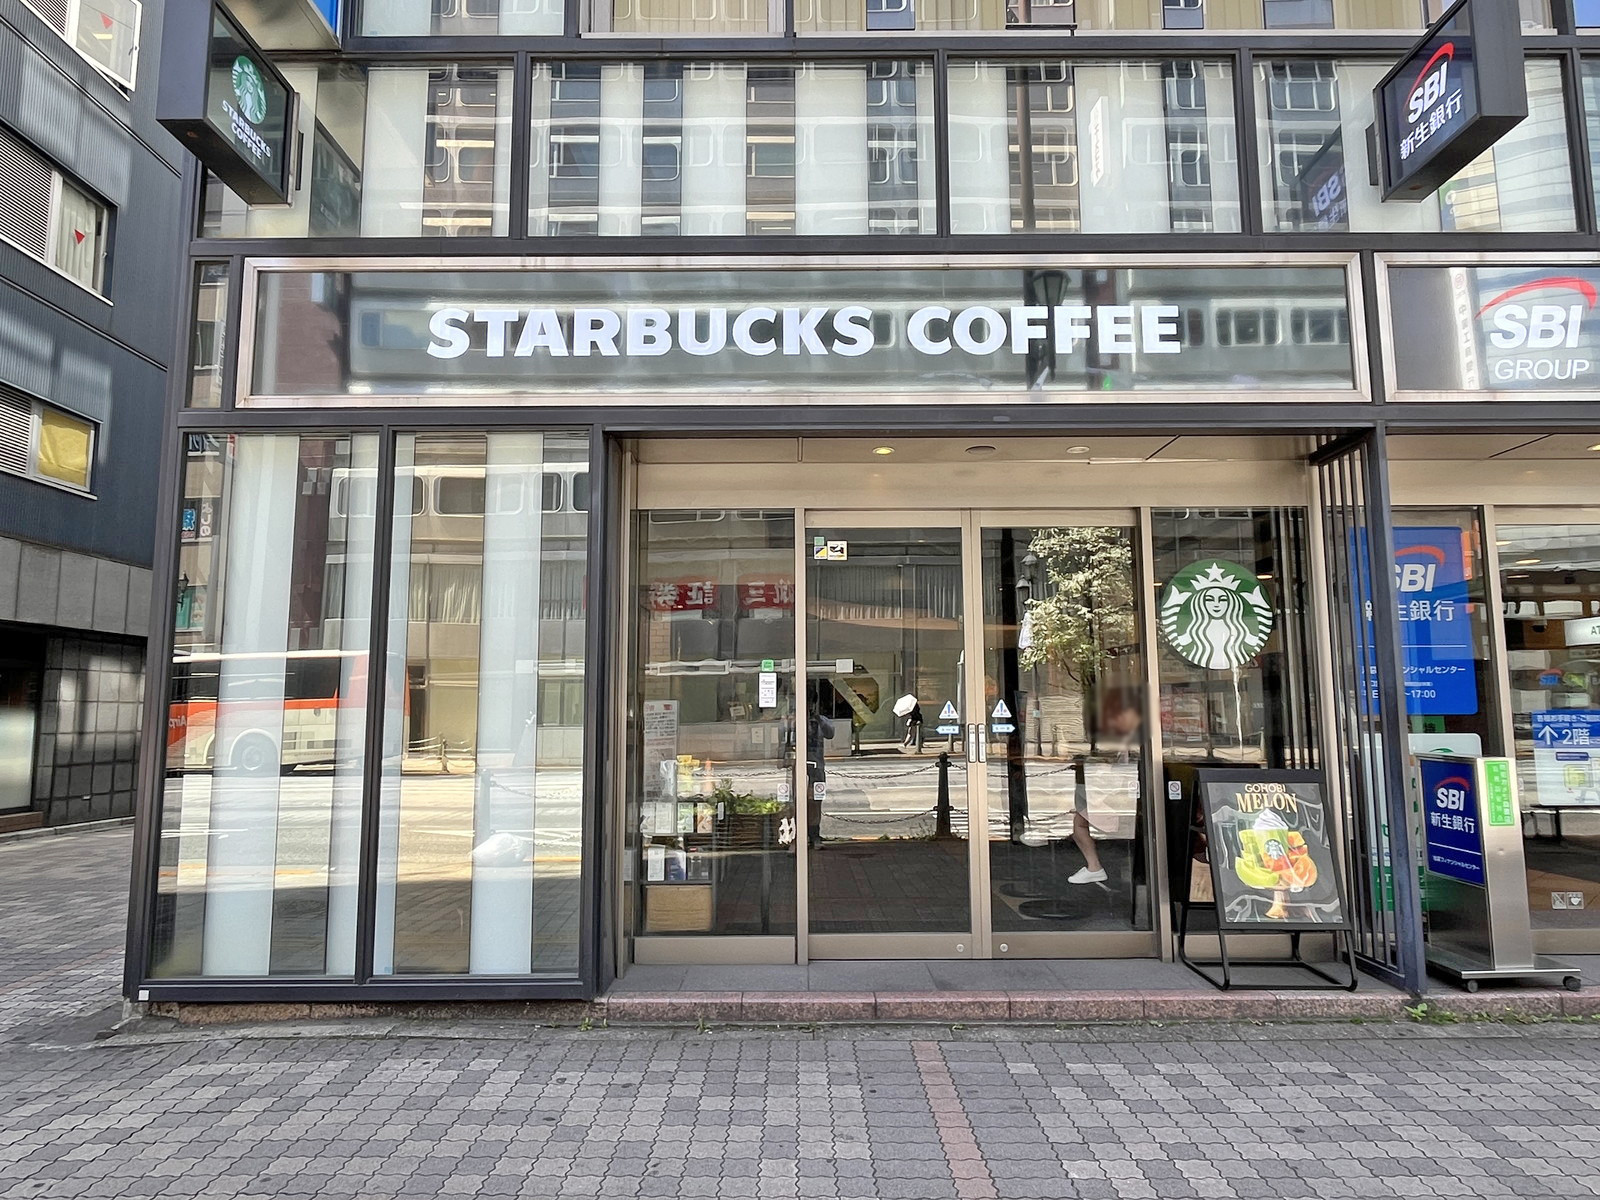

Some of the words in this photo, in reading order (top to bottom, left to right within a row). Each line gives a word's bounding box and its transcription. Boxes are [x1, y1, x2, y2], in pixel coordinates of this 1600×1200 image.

[1408, 61, 1448, 124] SBI
[222, 100, 271, 157] STARBUCKS
[1400, 88, 1463, 160] 新生銀行
[231, 122, 262, 159] COFFEE
[426, 306, 875, 359] STARBUCKS
[907, 305, 1182, 355] COFFEE
[1490, 304, 1583, 349] SBI
[1494, 358, 1590, 380] GROUP
[1395, 564, 1436, 592] BI
[1562, 728, 1590, 745] 2階
[1235, 792, 1298, 813] MELON
[1245, 784, 1286, 793] GOHOBI
[1436, 788, 1465, 811] SBI
[1431, 812, 1475, 834] 新生銀行
